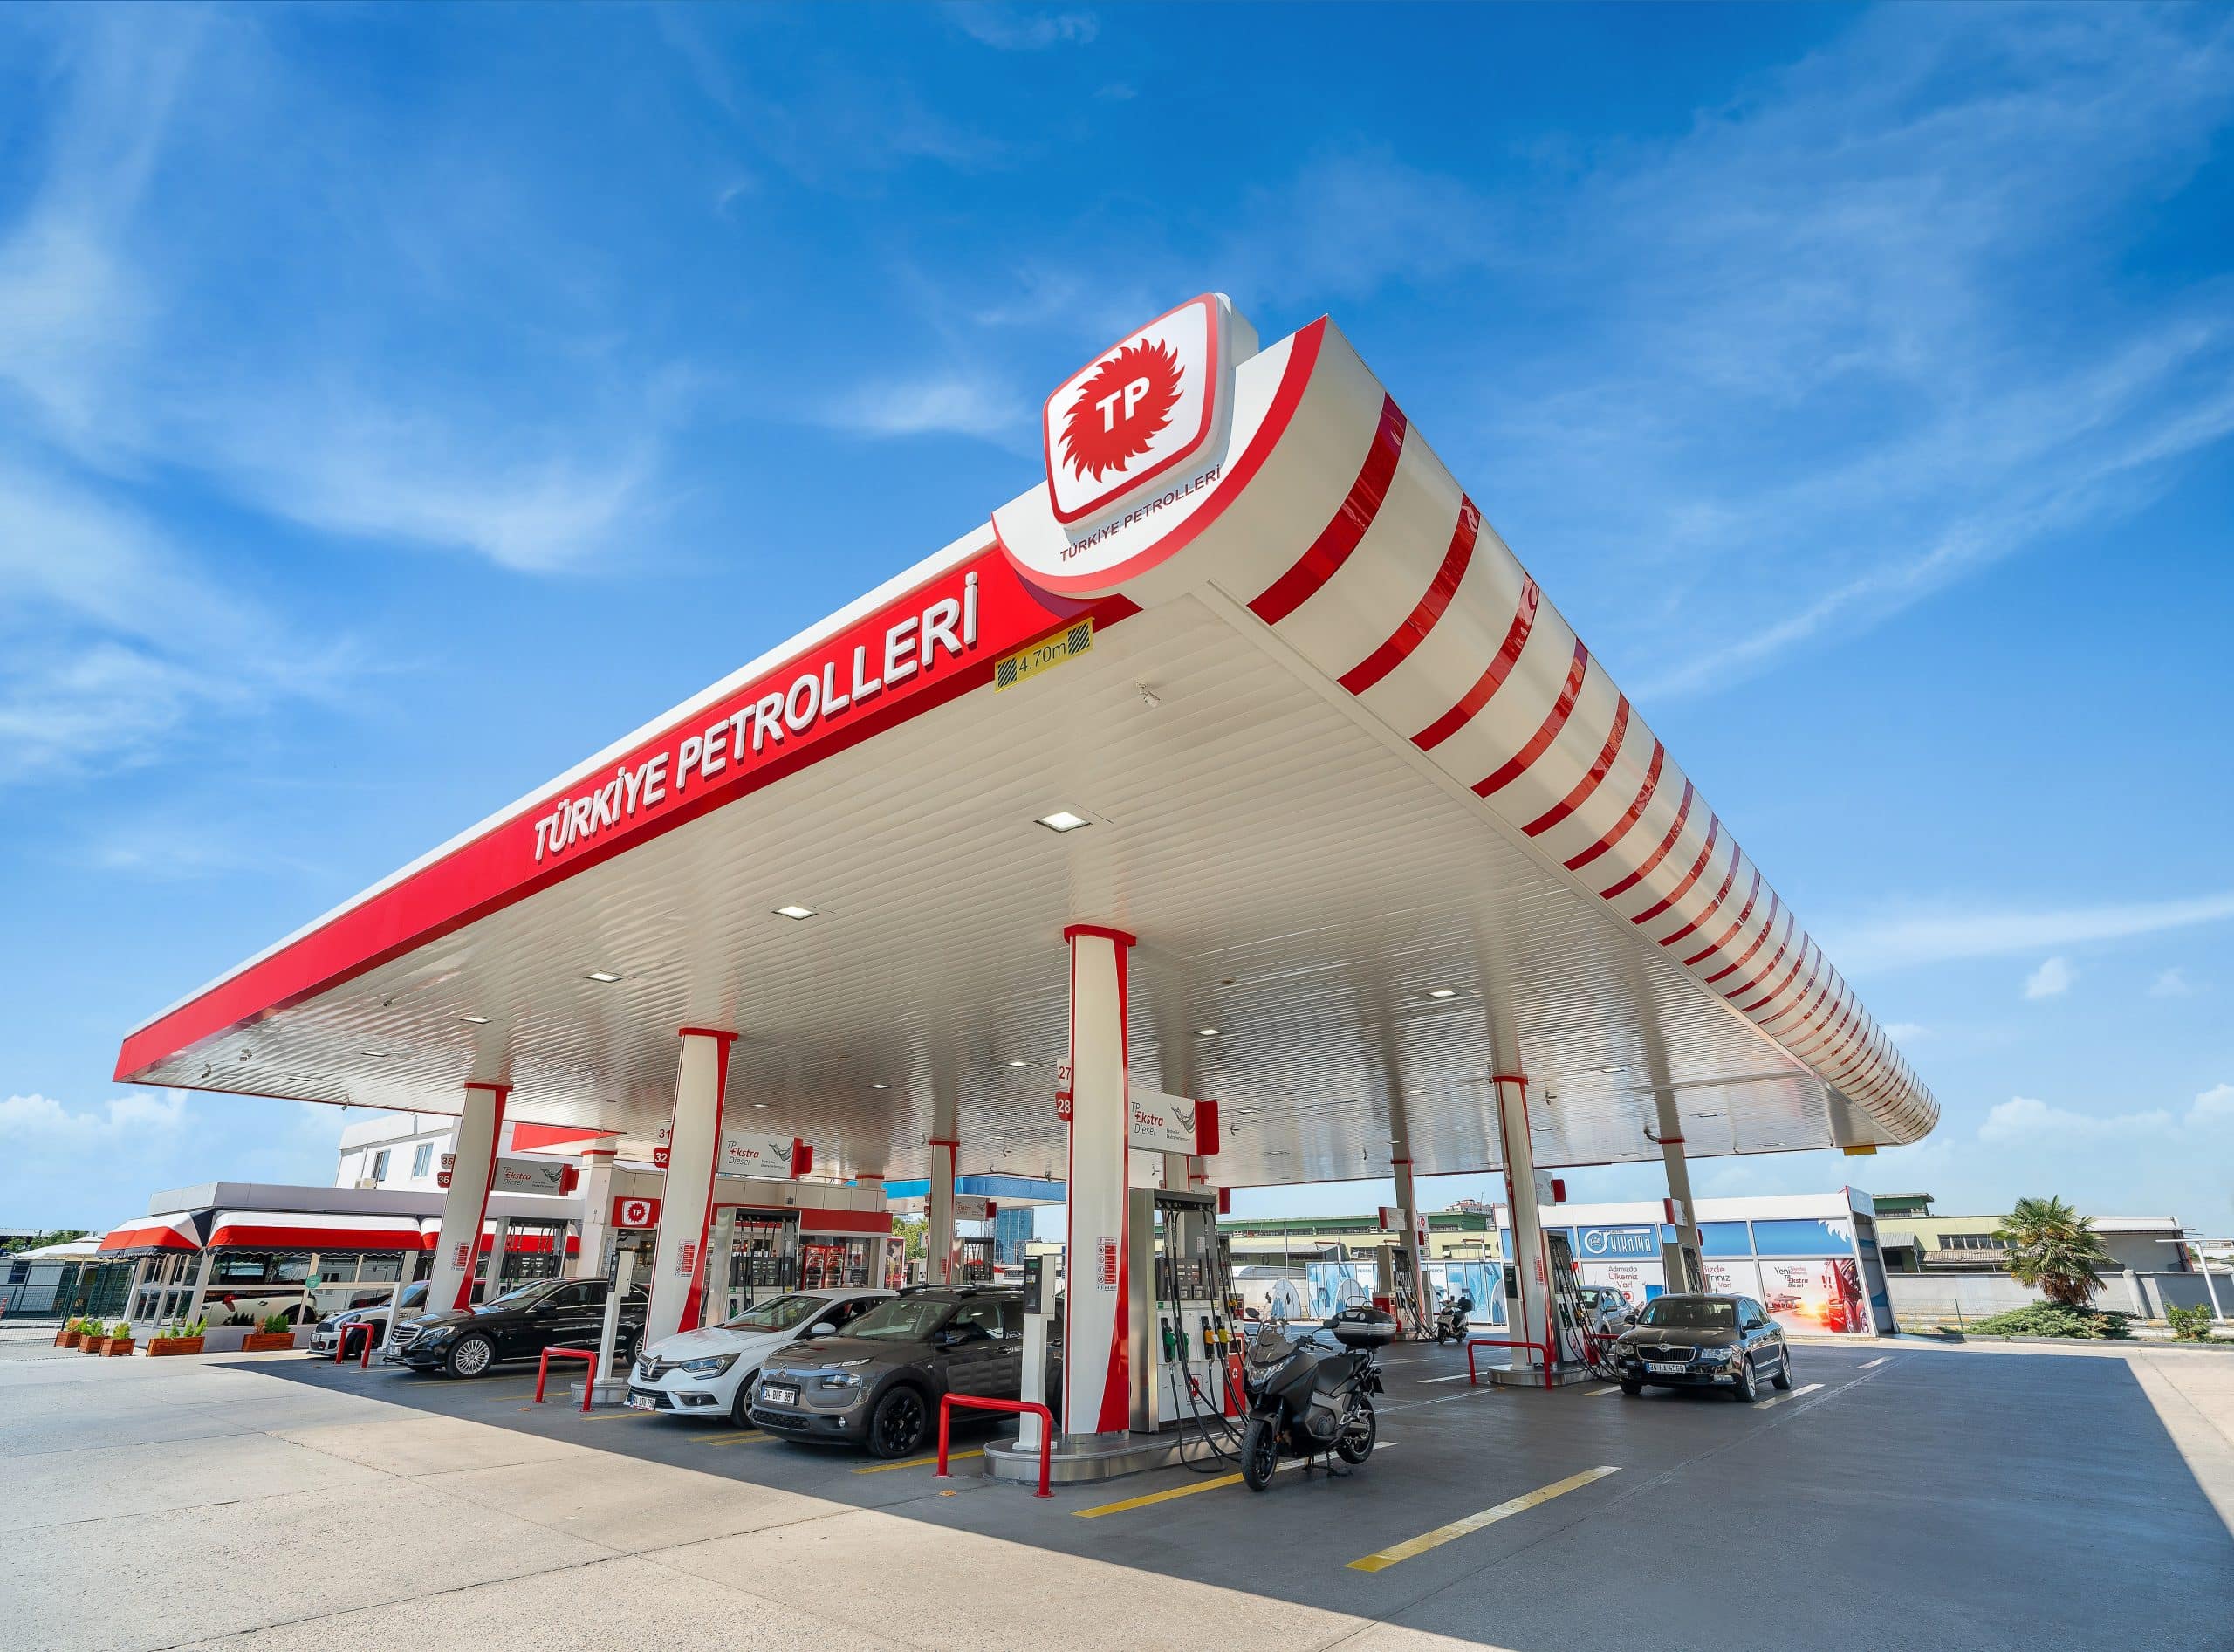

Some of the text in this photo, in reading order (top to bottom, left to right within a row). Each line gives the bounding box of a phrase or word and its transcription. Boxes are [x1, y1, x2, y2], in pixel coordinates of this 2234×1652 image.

[1095, 376, 1150, 433] TP
[1059, 463, 1221, 563] TÜRKİYE PETROLLERİ
[1018, 639, 1067, 673] 4.70m
[533, 570, 977, 860] TÜRKİYE PETROLLERİ
[1059, 1066, 1072, 1080] 27
[1057, 1099, 1071, 1113] 28
[1134, 1111, 1164, 1127] Ekstra
[658, 1128, 671, 1139] 31
[1134, 1123, 1156, 1136] Diesel
[654, 1153, 668, 1163] 32
[730, 1148, 760, 1158] Ekstra
[728, 1156, 751, 1166] Diesel
[1774, 1266, 1790, 1275] Yeni
